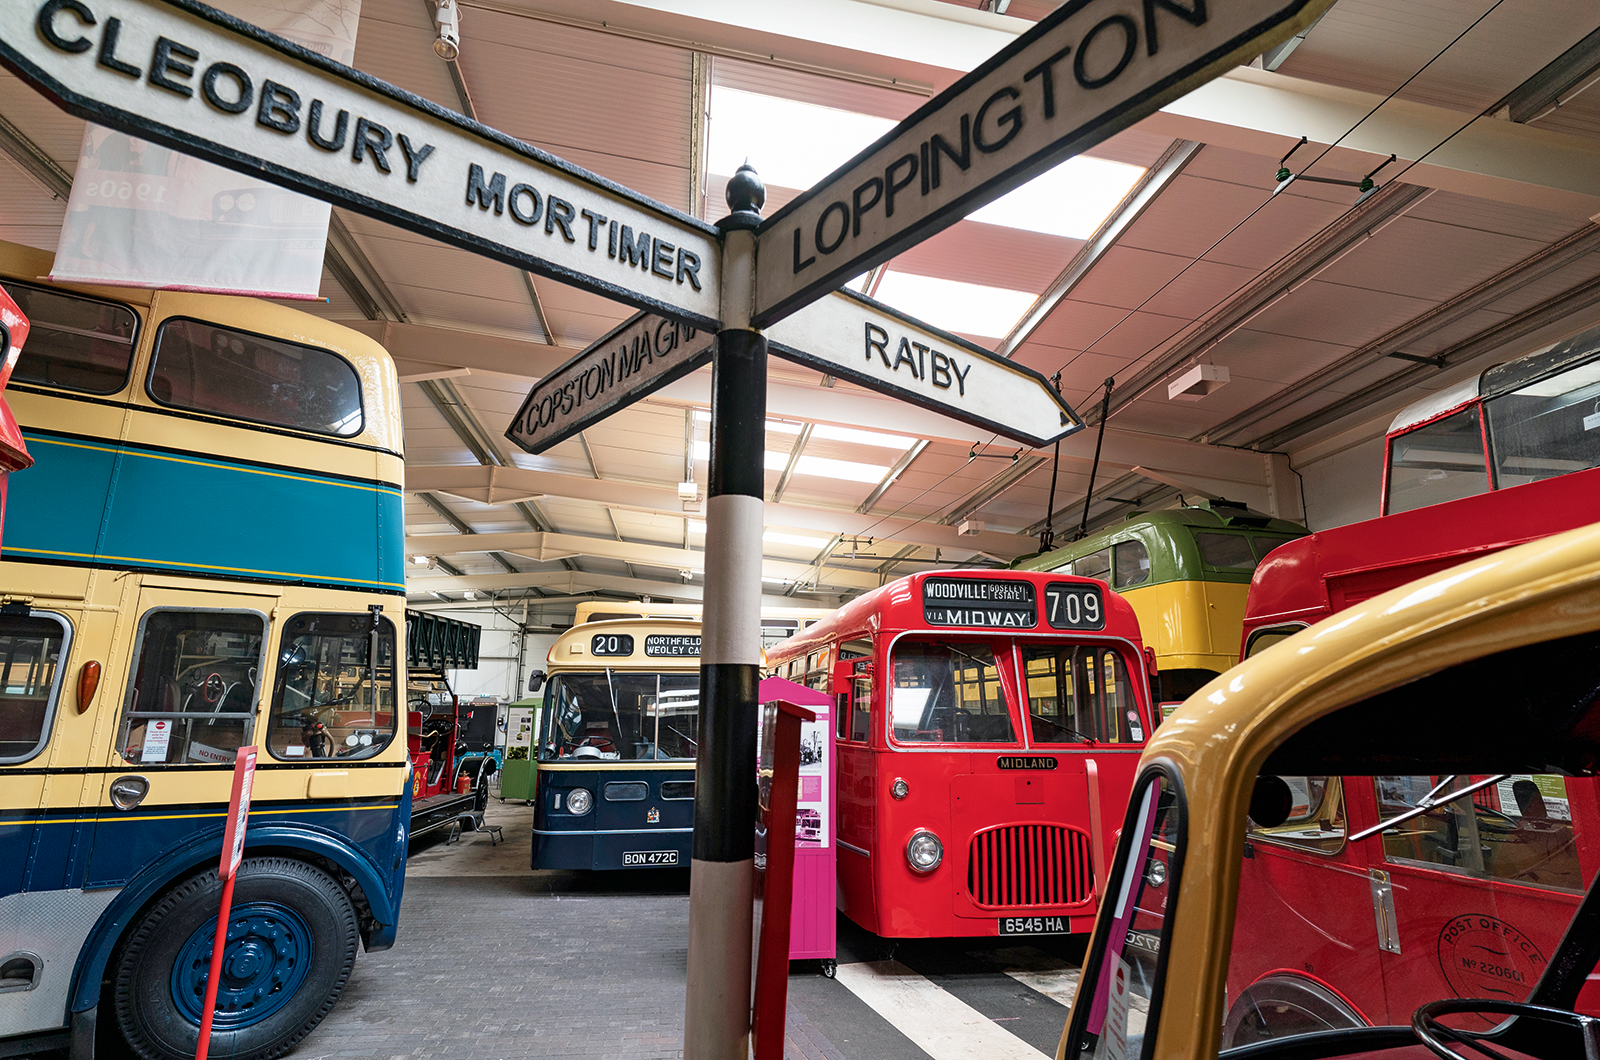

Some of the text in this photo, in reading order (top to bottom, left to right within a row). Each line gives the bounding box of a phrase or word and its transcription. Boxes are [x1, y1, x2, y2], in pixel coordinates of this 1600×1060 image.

[792, 0, 1207, 274] LOPPINGTON
[37, 0, 702, 291] CLEOBURY MORTIMER
[865, 321, 971, 397] RATBY
[526, 352, 615, 435] COPSTON
[926, 583, 987, 599] WOODVILLE
[990, 584, 1023, 593] GOSELEY
[994, 591, 1020, 600] ESTATE
[1046, 592, 1100, 624] 709
[926, 610, 1027, 627] VIA MIDWAY
[595, 636, 618, 653] 20
[647, 636, 702, 646] NORTHFIELD
[647, 646, 702, 655] WEOLEY CA
[199, 749, 231, 763] NO ENTRY
[1000, 757, 1054, 768] MIDLAND
[625, 852, 677, 864] BON 472C
[1005, 917, 1064, 933] 6545 HA
[1443, 918, 1542, 965] POST OFFICE
[1480, 961, 1526, 983] 220601
